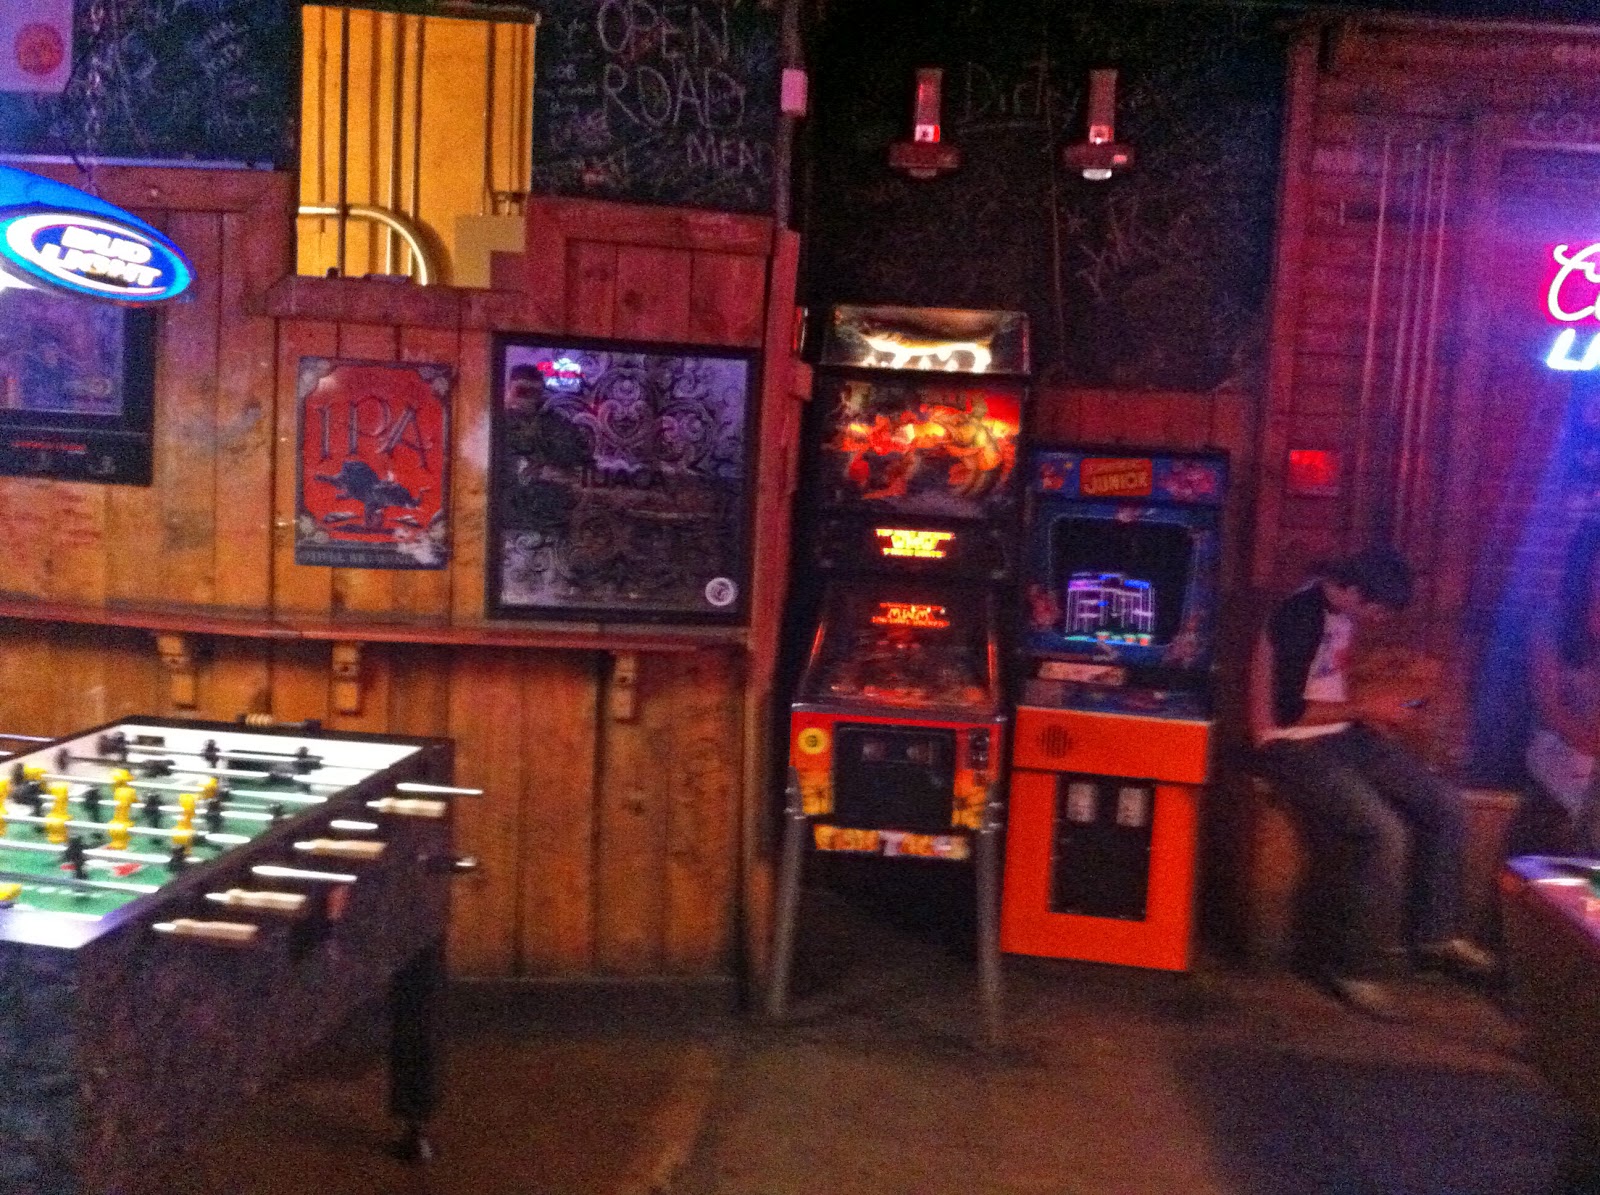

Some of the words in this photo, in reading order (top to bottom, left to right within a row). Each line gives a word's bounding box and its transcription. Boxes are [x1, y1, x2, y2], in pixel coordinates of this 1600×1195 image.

[596, 0, 730, 61] OPEN
[603, 62, 747, 132] ROAD
[40, 242, 162, 287] LIGHT
[60, 225, 152, 264] BUD
[315, 394, 433, 472] IPA
